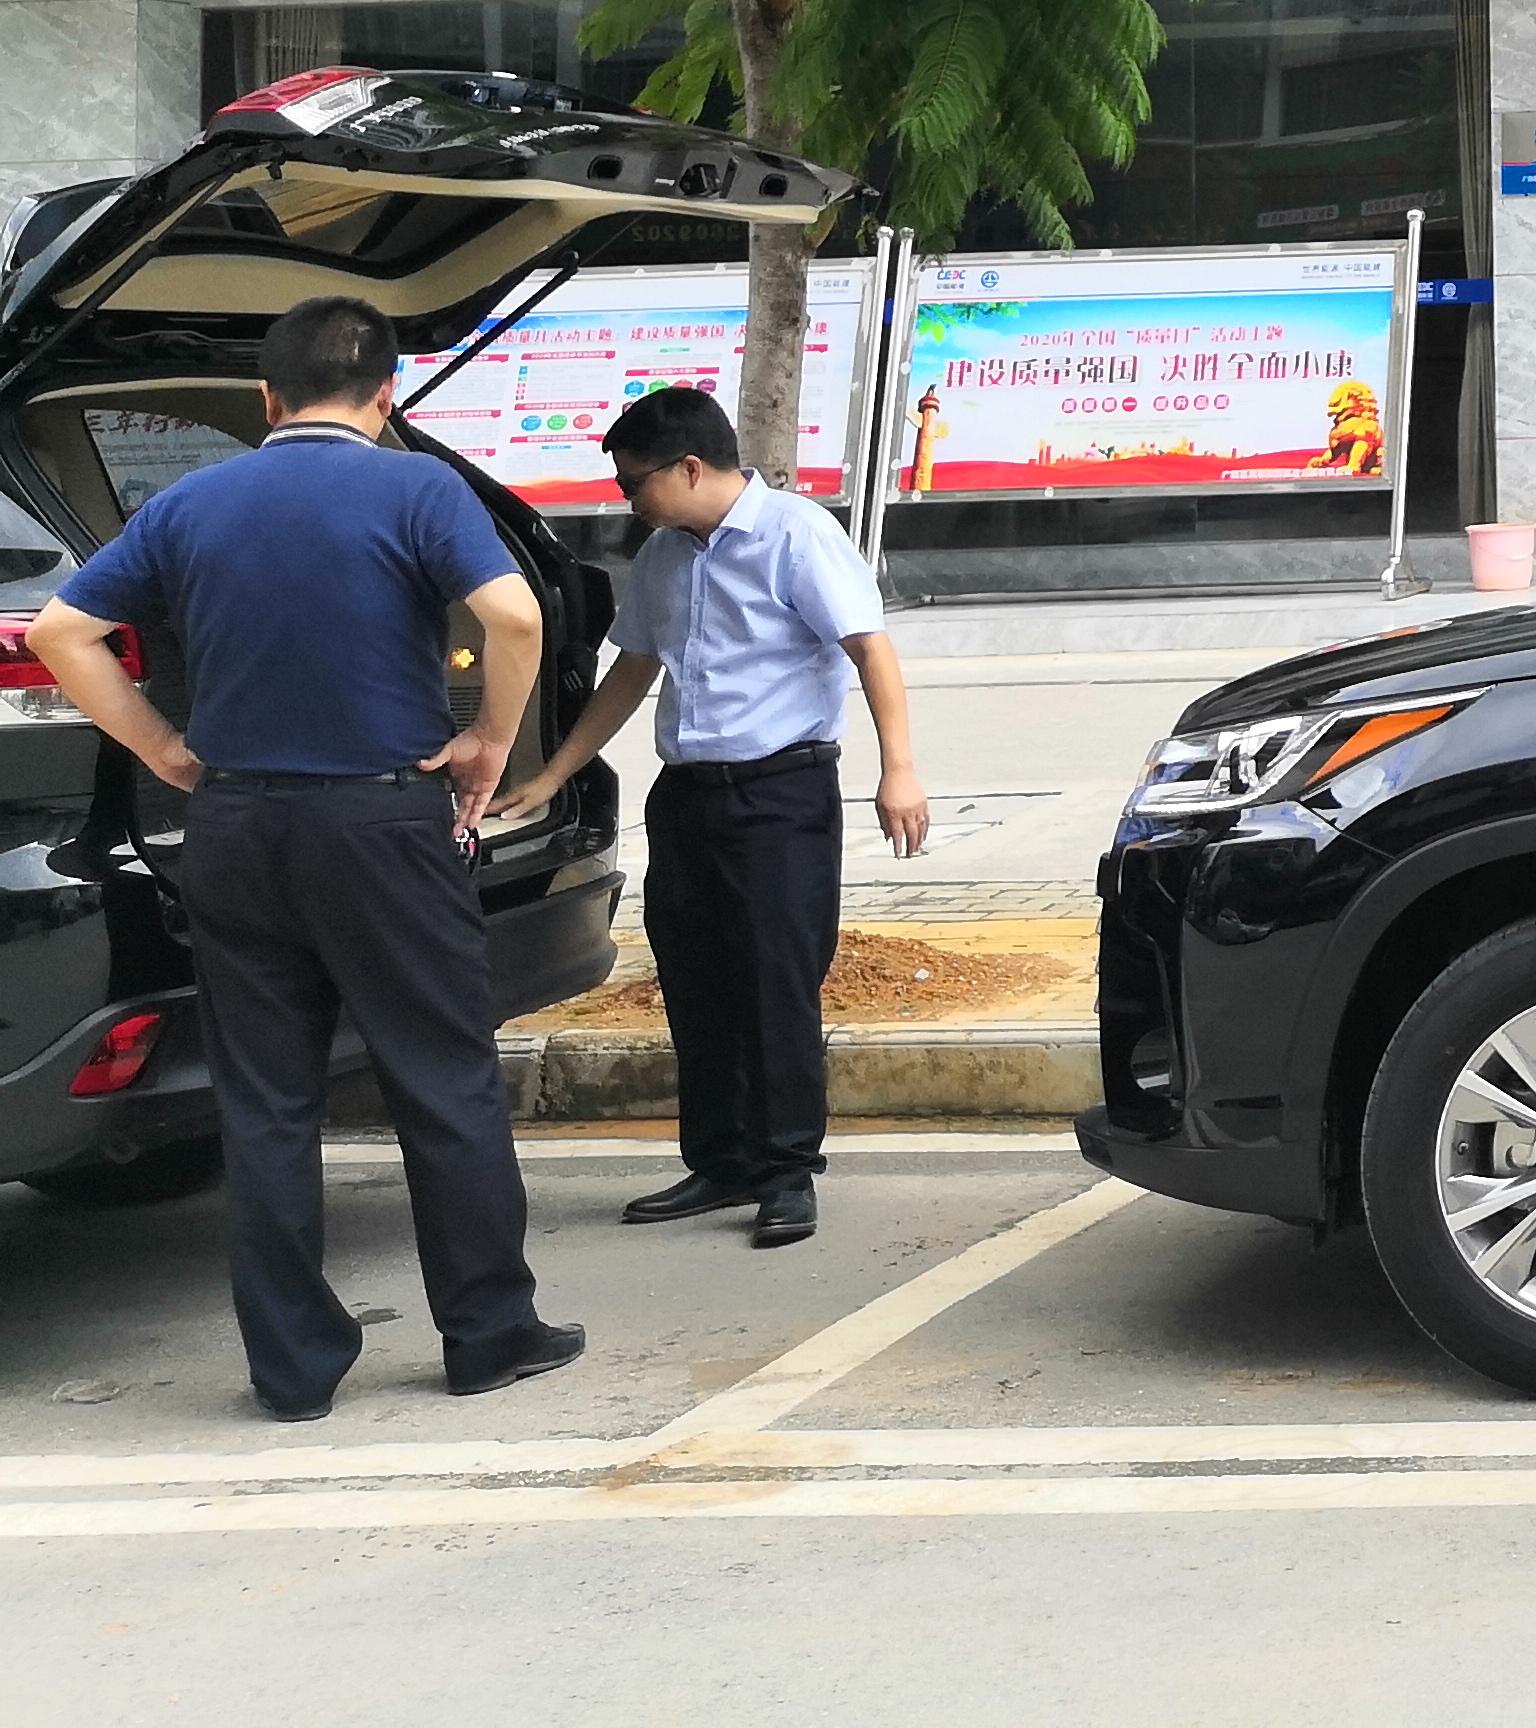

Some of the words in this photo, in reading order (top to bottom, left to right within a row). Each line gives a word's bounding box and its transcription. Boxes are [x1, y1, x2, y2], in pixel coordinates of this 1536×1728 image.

[946, 355, 1138, 388] 建设质量强国
[1160, 349, 1353, 382] 决胜全面小康
